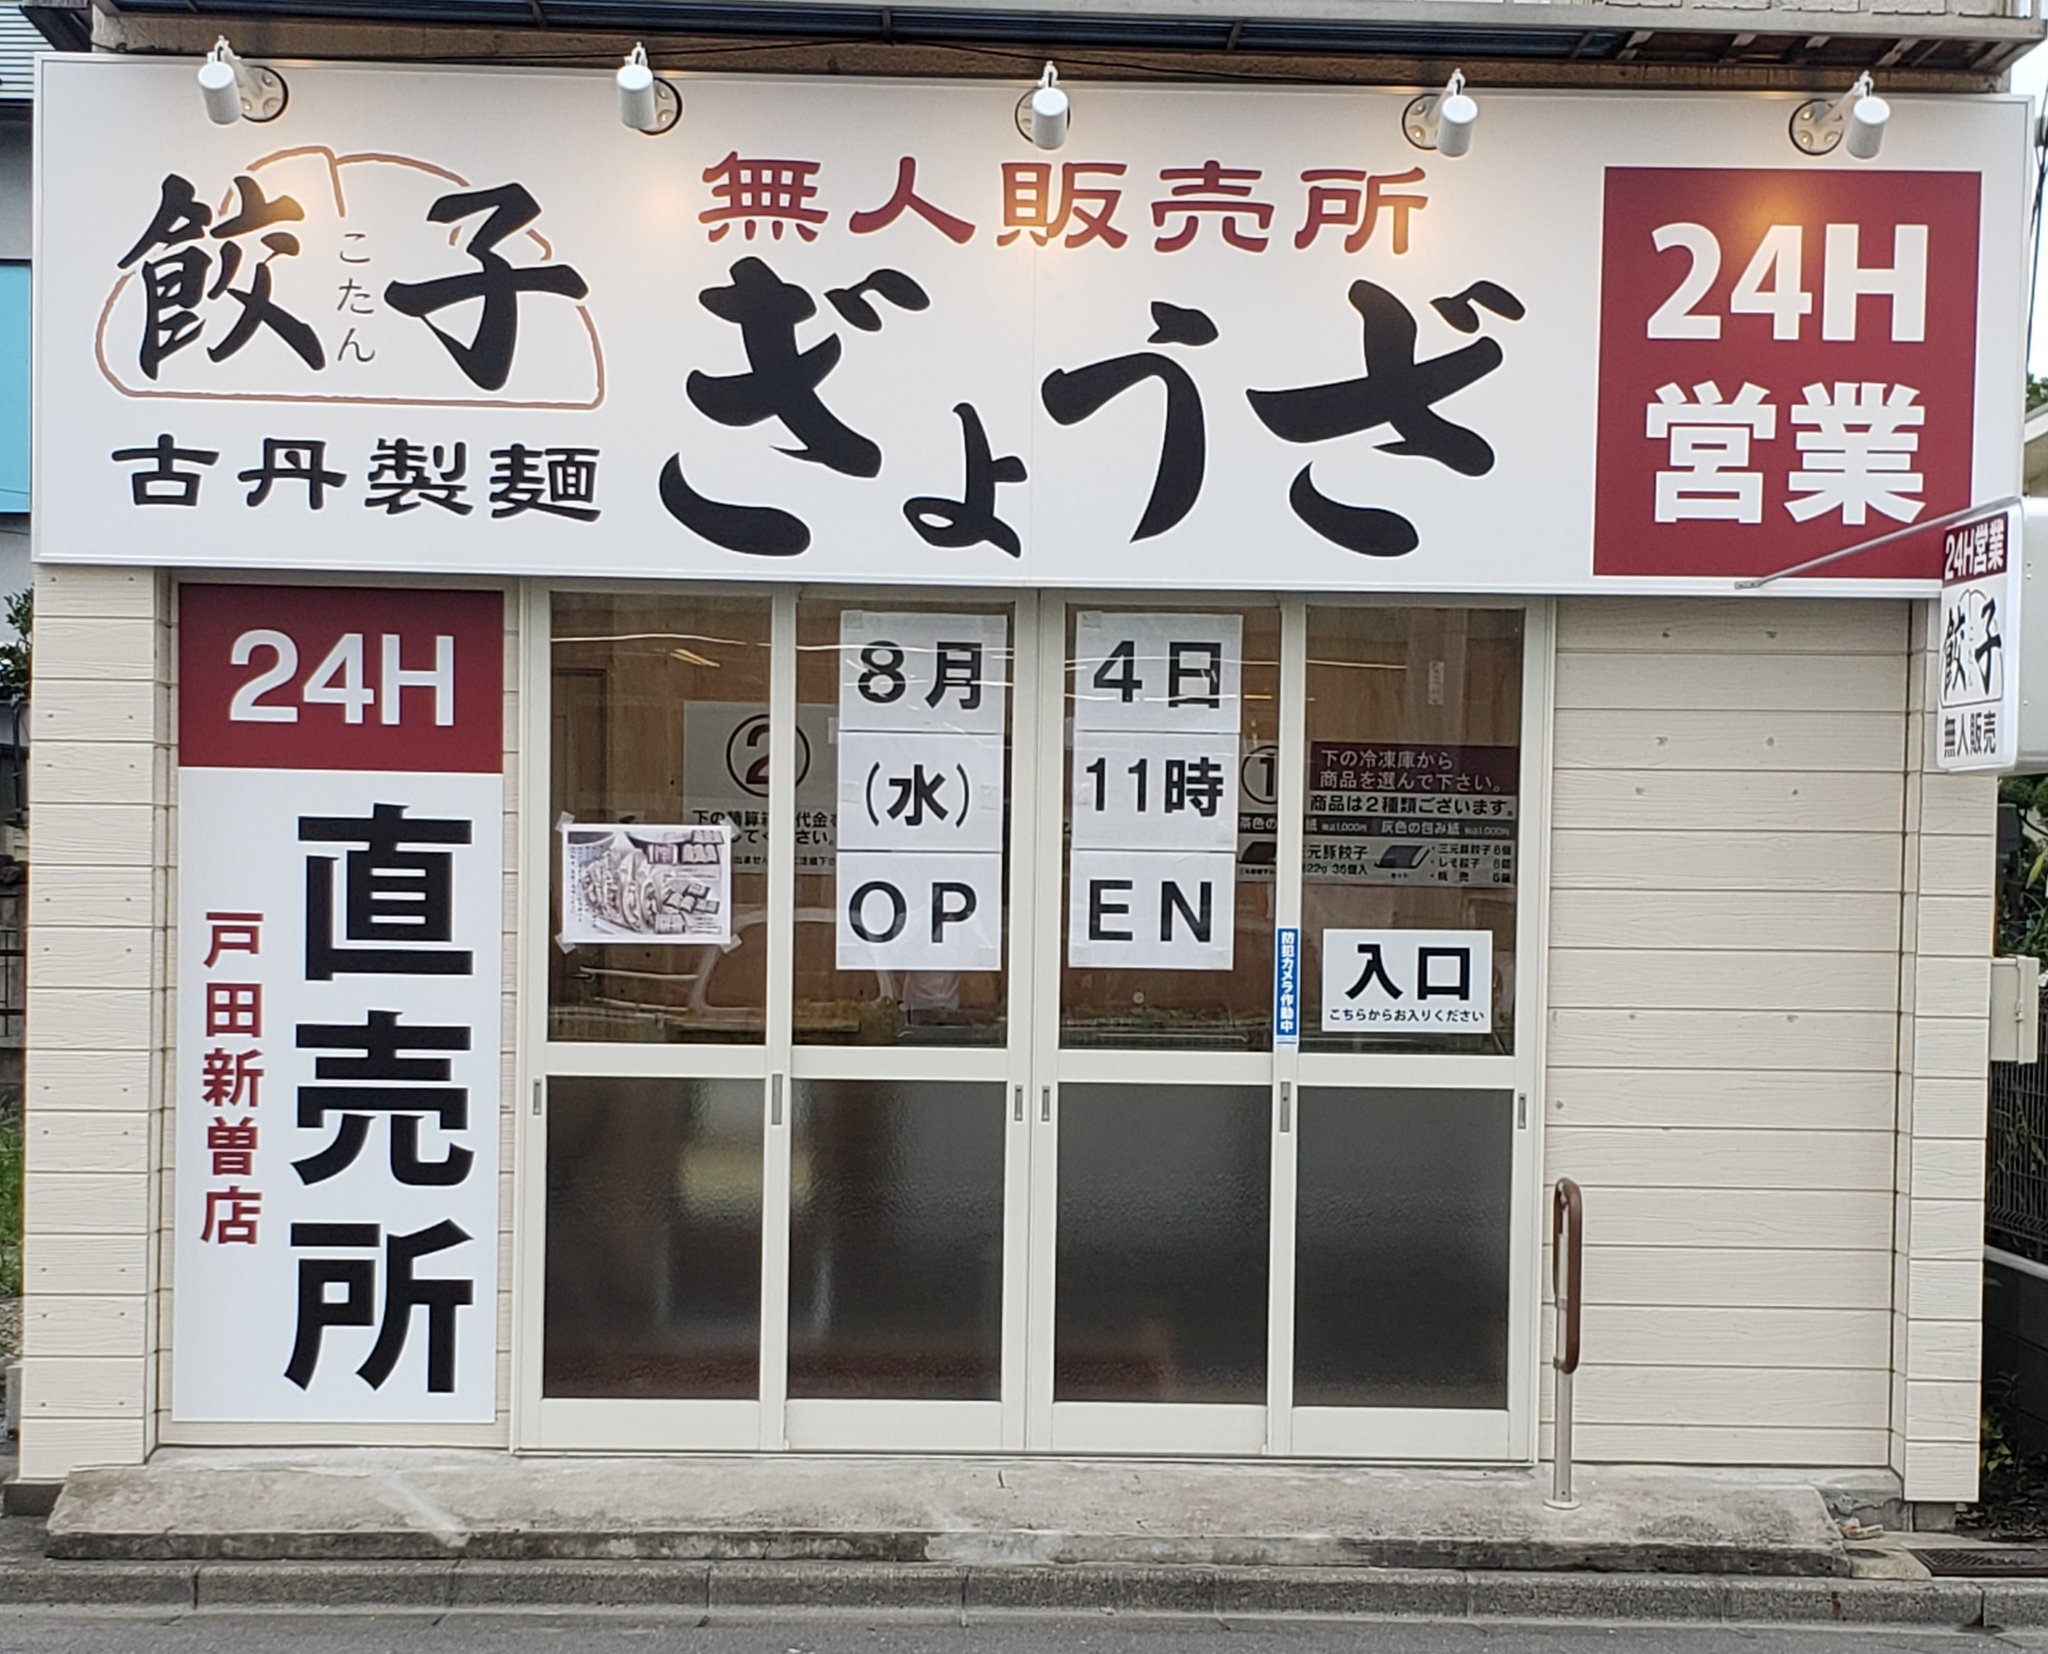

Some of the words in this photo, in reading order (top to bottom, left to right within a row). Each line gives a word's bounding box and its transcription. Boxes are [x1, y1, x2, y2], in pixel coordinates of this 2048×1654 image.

[699, 150, 1428, 255] 無人販売所
[117, 173, 589, 391] 餃子
[337, 232, 376, 364] こたん
[1647, 222, 1929, 342] 24H
[659, 256, 1525, 557] ぎょうざ
[1646, 380, 1926, 526] 営業
[112, 434, 602, 522] 古丹製麺
[1944, 518, 2005, 581] 24H営業
[229, 629, 454, 727] 24H
[1320, 770, 1500, 793] 商品を選んで下さい。
[1321, 749, 1453, 770] 下の冷凍庫から
[1944, 711, 1997, 758] 無人販売
[1280, 931, 1296, 1033] 防犯カメラ作動中
[1328, 1008, 1486, 1024] こちらからお入りください
[1345, 943, 1471, 1001] 入口
[201, 911, 265, 1246] 戸田新曽店
[284, 803, 474, 1393] 直売所
